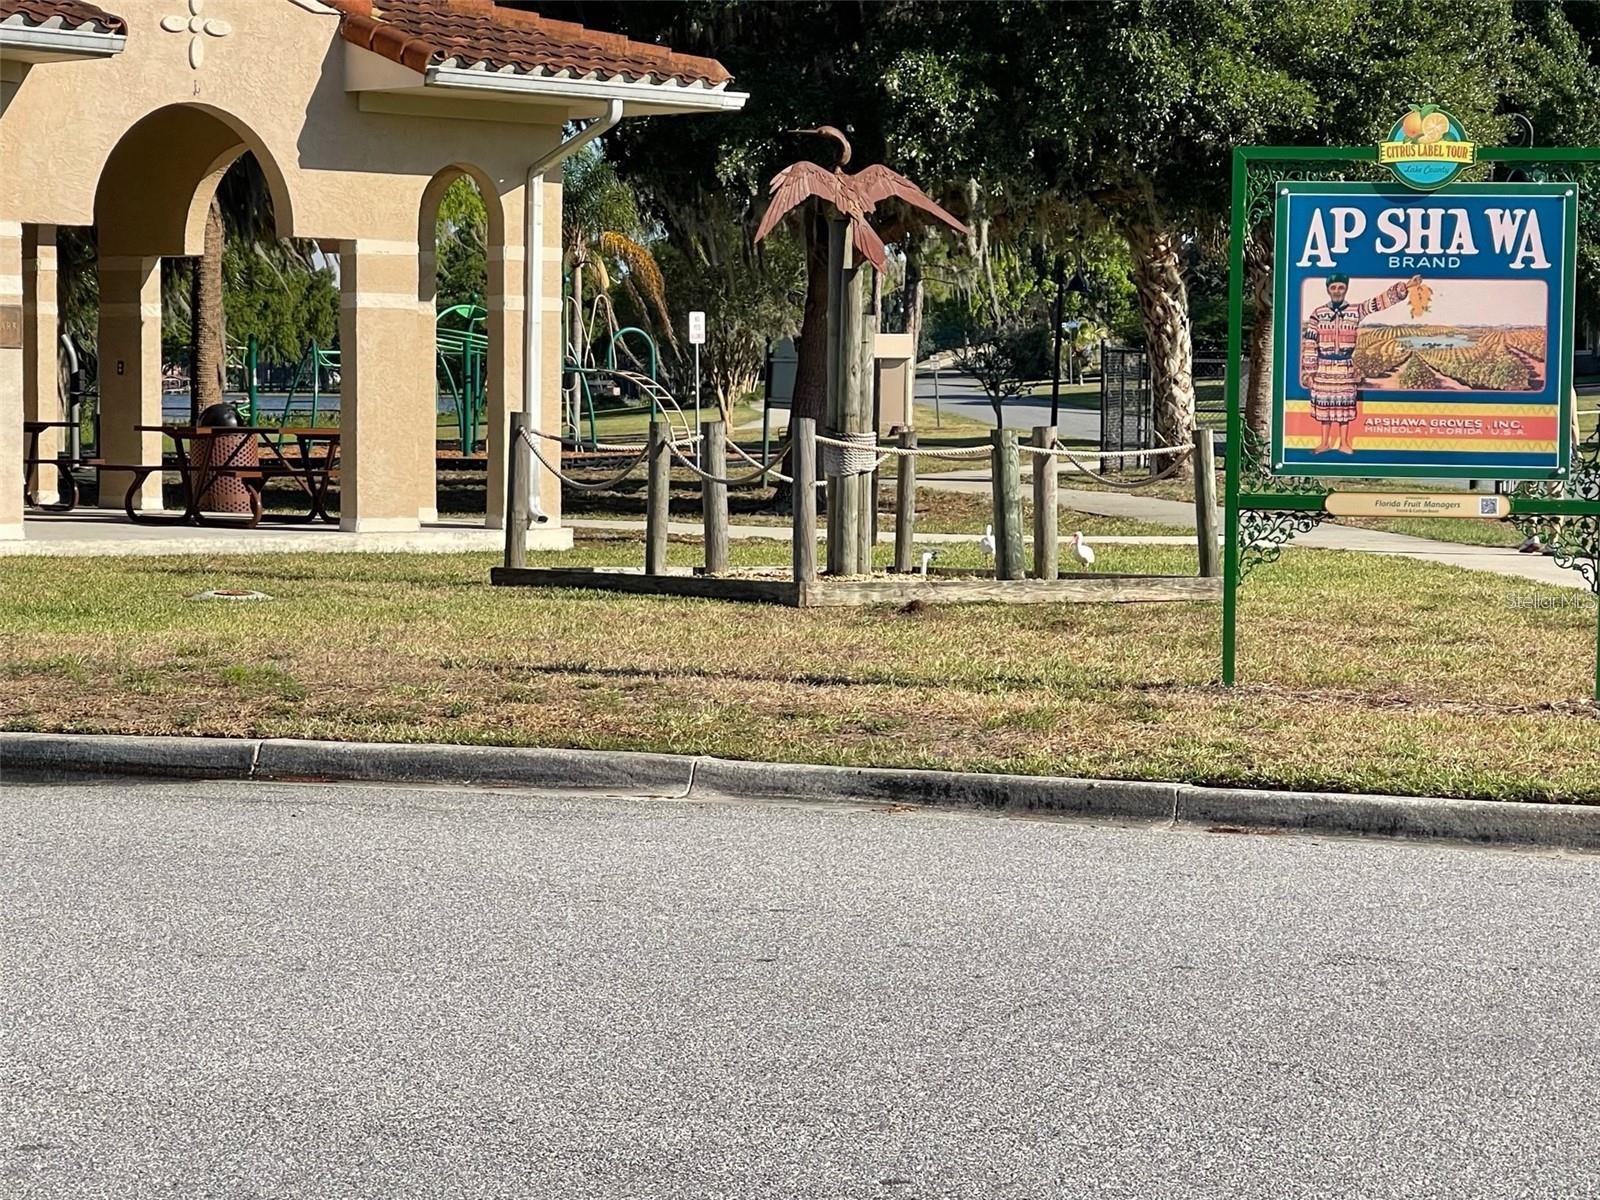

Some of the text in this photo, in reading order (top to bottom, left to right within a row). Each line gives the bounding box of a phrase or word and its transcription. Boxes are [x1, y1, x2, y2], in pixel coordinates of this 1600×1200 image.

[1386, 144, 1469, 159] CITRUS LABEL TOUR
[1404, 164, 1450, 175] Lake County
[1388, 256, 1462, 269] BRAND
[1364, 417, 1427, 427] APSHAWA
[1493, 420, 1525, 430] INC.
[1430, 426, 1484, 435] FLORIDA
[1375, 499, 1461, 510] Florida Fruit Managers
